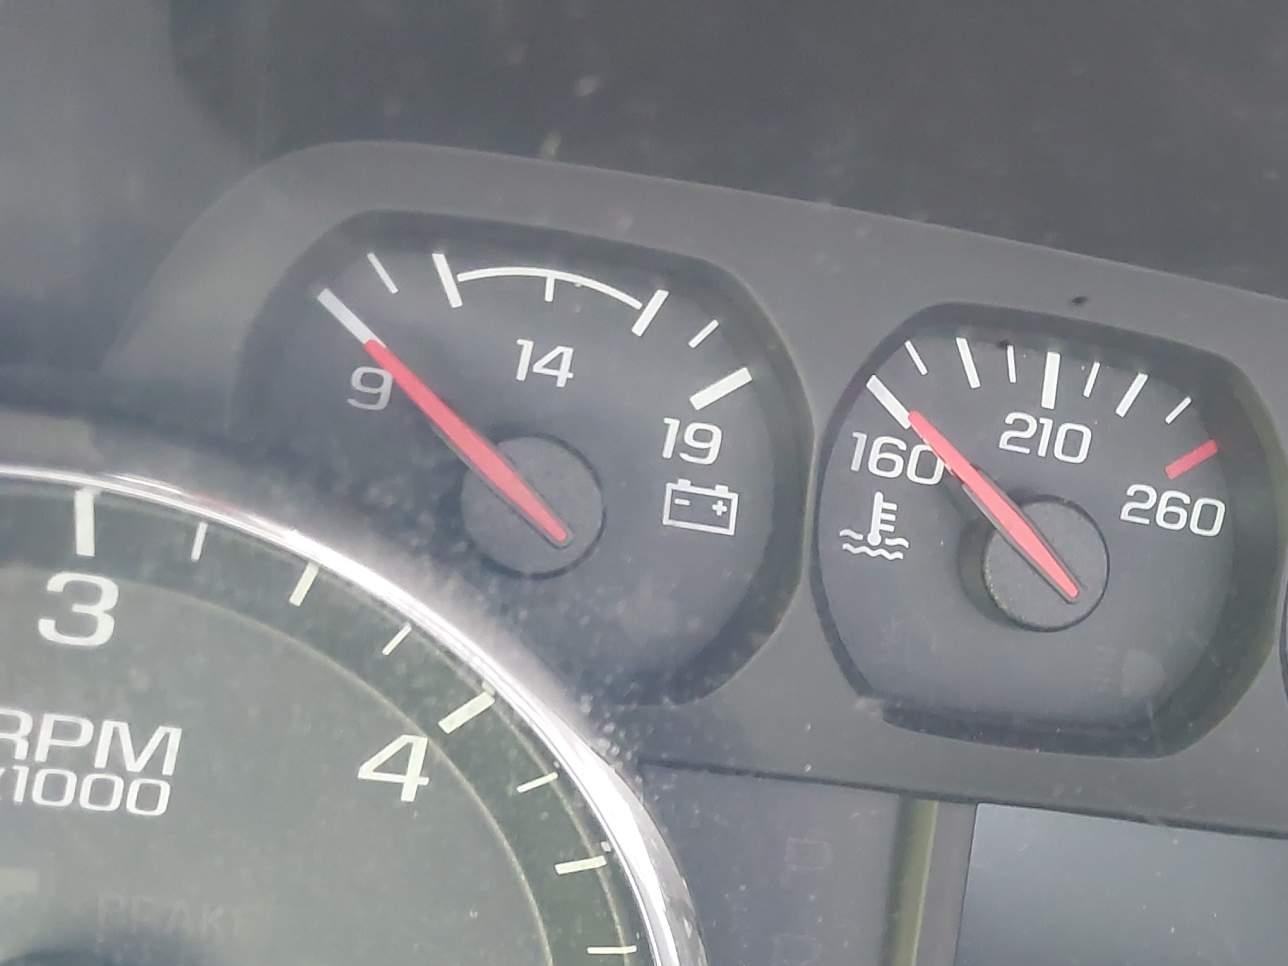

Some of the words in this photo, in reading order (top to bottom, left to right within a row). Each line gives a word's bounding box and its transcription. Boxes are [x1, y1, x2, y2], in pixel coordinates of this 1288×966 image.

[347, 366, 393, 411] 9
[516, 338, 574, 388] 14
[662, 417, 722, 465] 19
[850, 431, 947, 486] 160
[998, 412, 1092, 464] 210
[1120, 483, 1226, 537] 260
[37, 571, 119, 647] 3
[0, 707, 183, 776] RPM
[357, 734, 430, 802] 4
[0, 765, 172, 817] 1000
